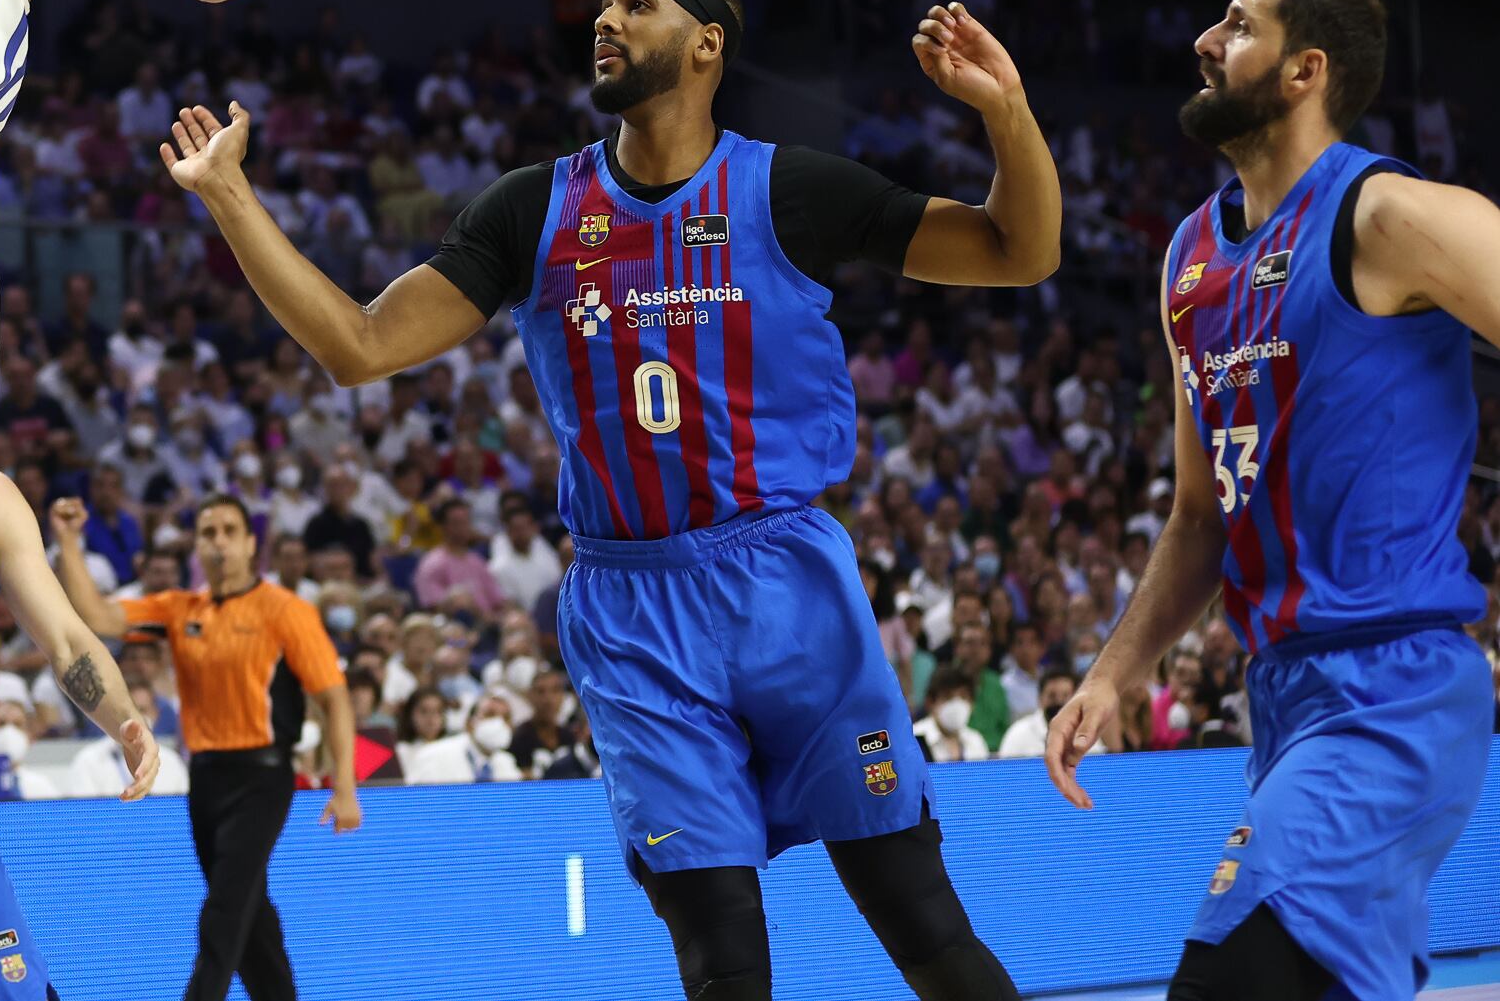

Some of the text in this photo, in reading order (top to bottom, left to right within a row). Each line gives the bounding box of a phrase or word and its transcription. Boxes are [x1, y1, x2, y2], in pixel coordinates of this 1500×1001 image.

[685, 224, 704, 235] liga
[686, 231, 726, 243] endesa
[624, 282, 743, 307] Assistència
[626, 307, 709, 328] Sanitària
[633, 360, 682, 434] 0
[1211, 424, 1260, 515] 33
[861, 739, 883, 752] acb
